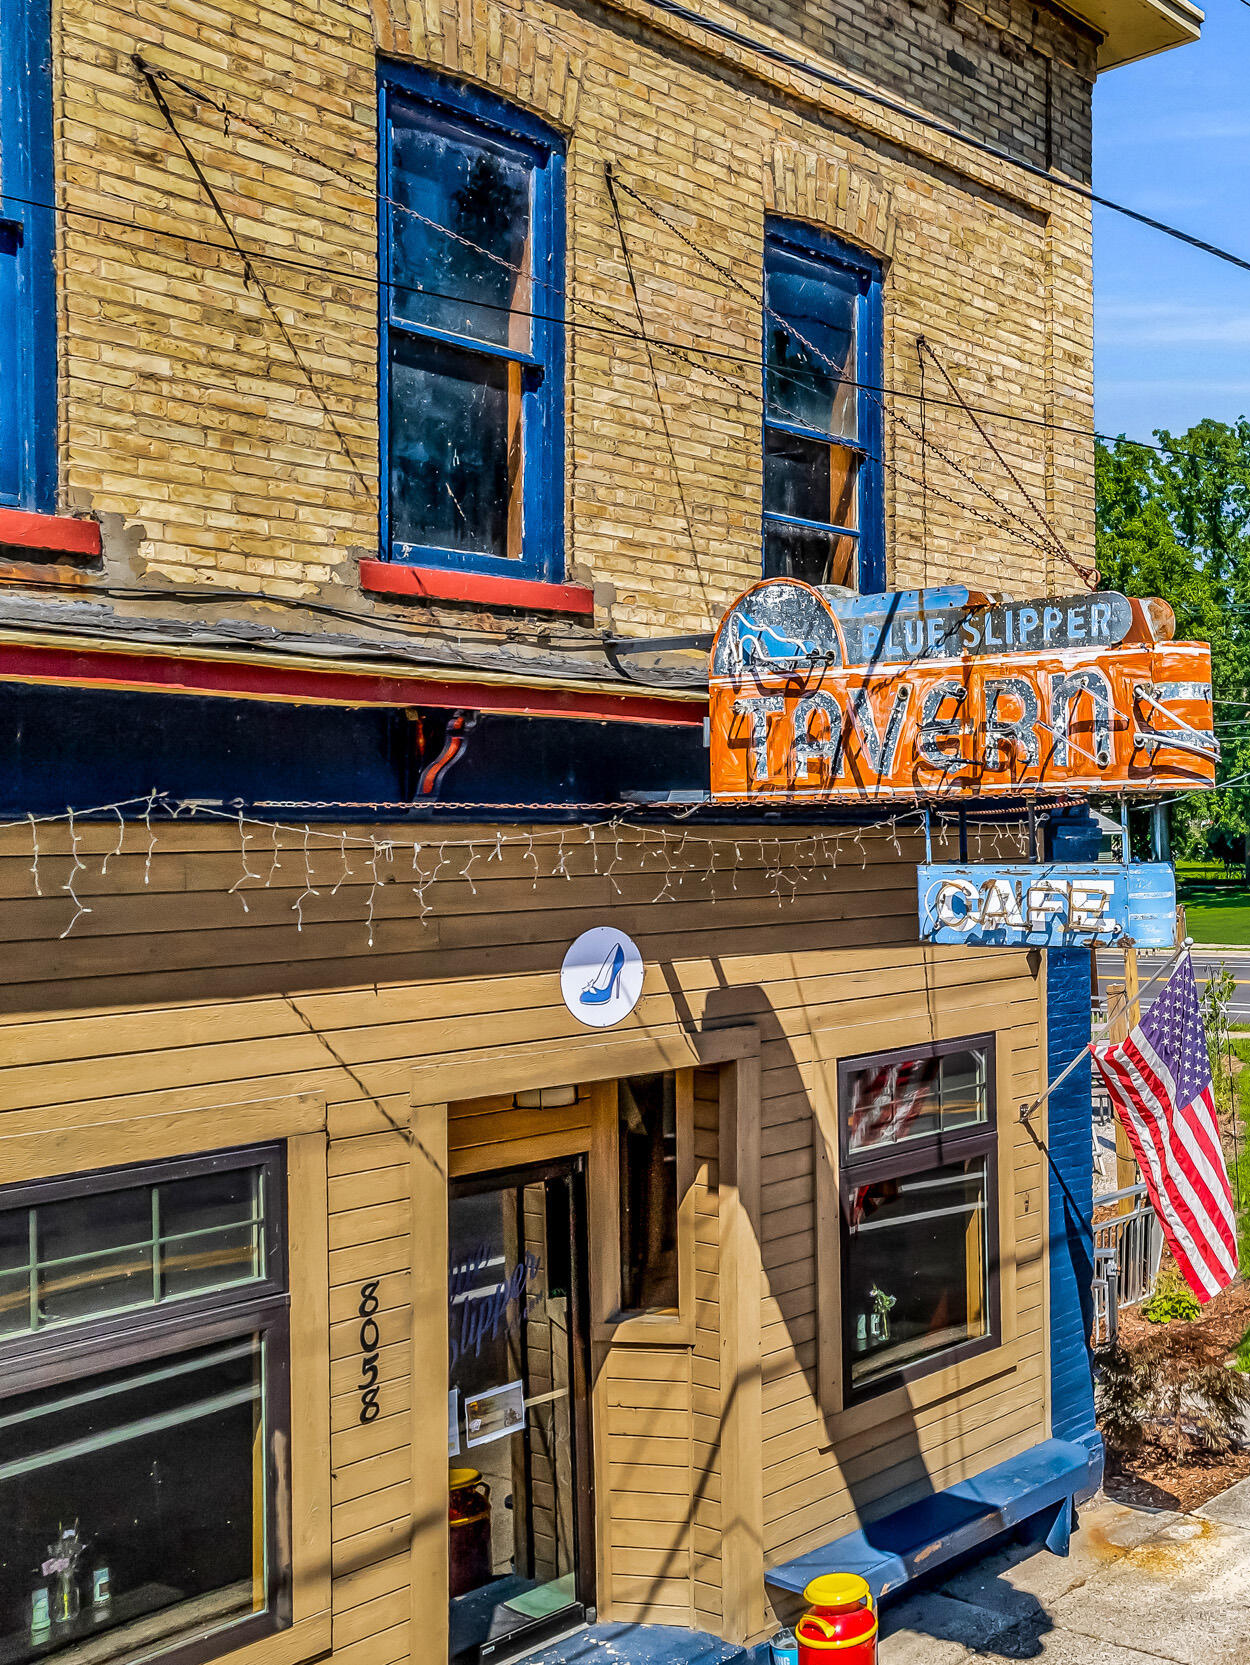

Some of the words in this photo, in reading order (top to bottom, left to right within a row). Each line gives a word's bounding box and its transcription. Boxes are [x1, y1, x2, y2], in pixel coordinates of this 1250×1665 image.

[861, 617, 946, 658] BLUE
[963, 602, 1112, 649] SLIPPER
[935, 877, 1117, 933] CAFE
[358, 1279, 380, 1425] 8058
